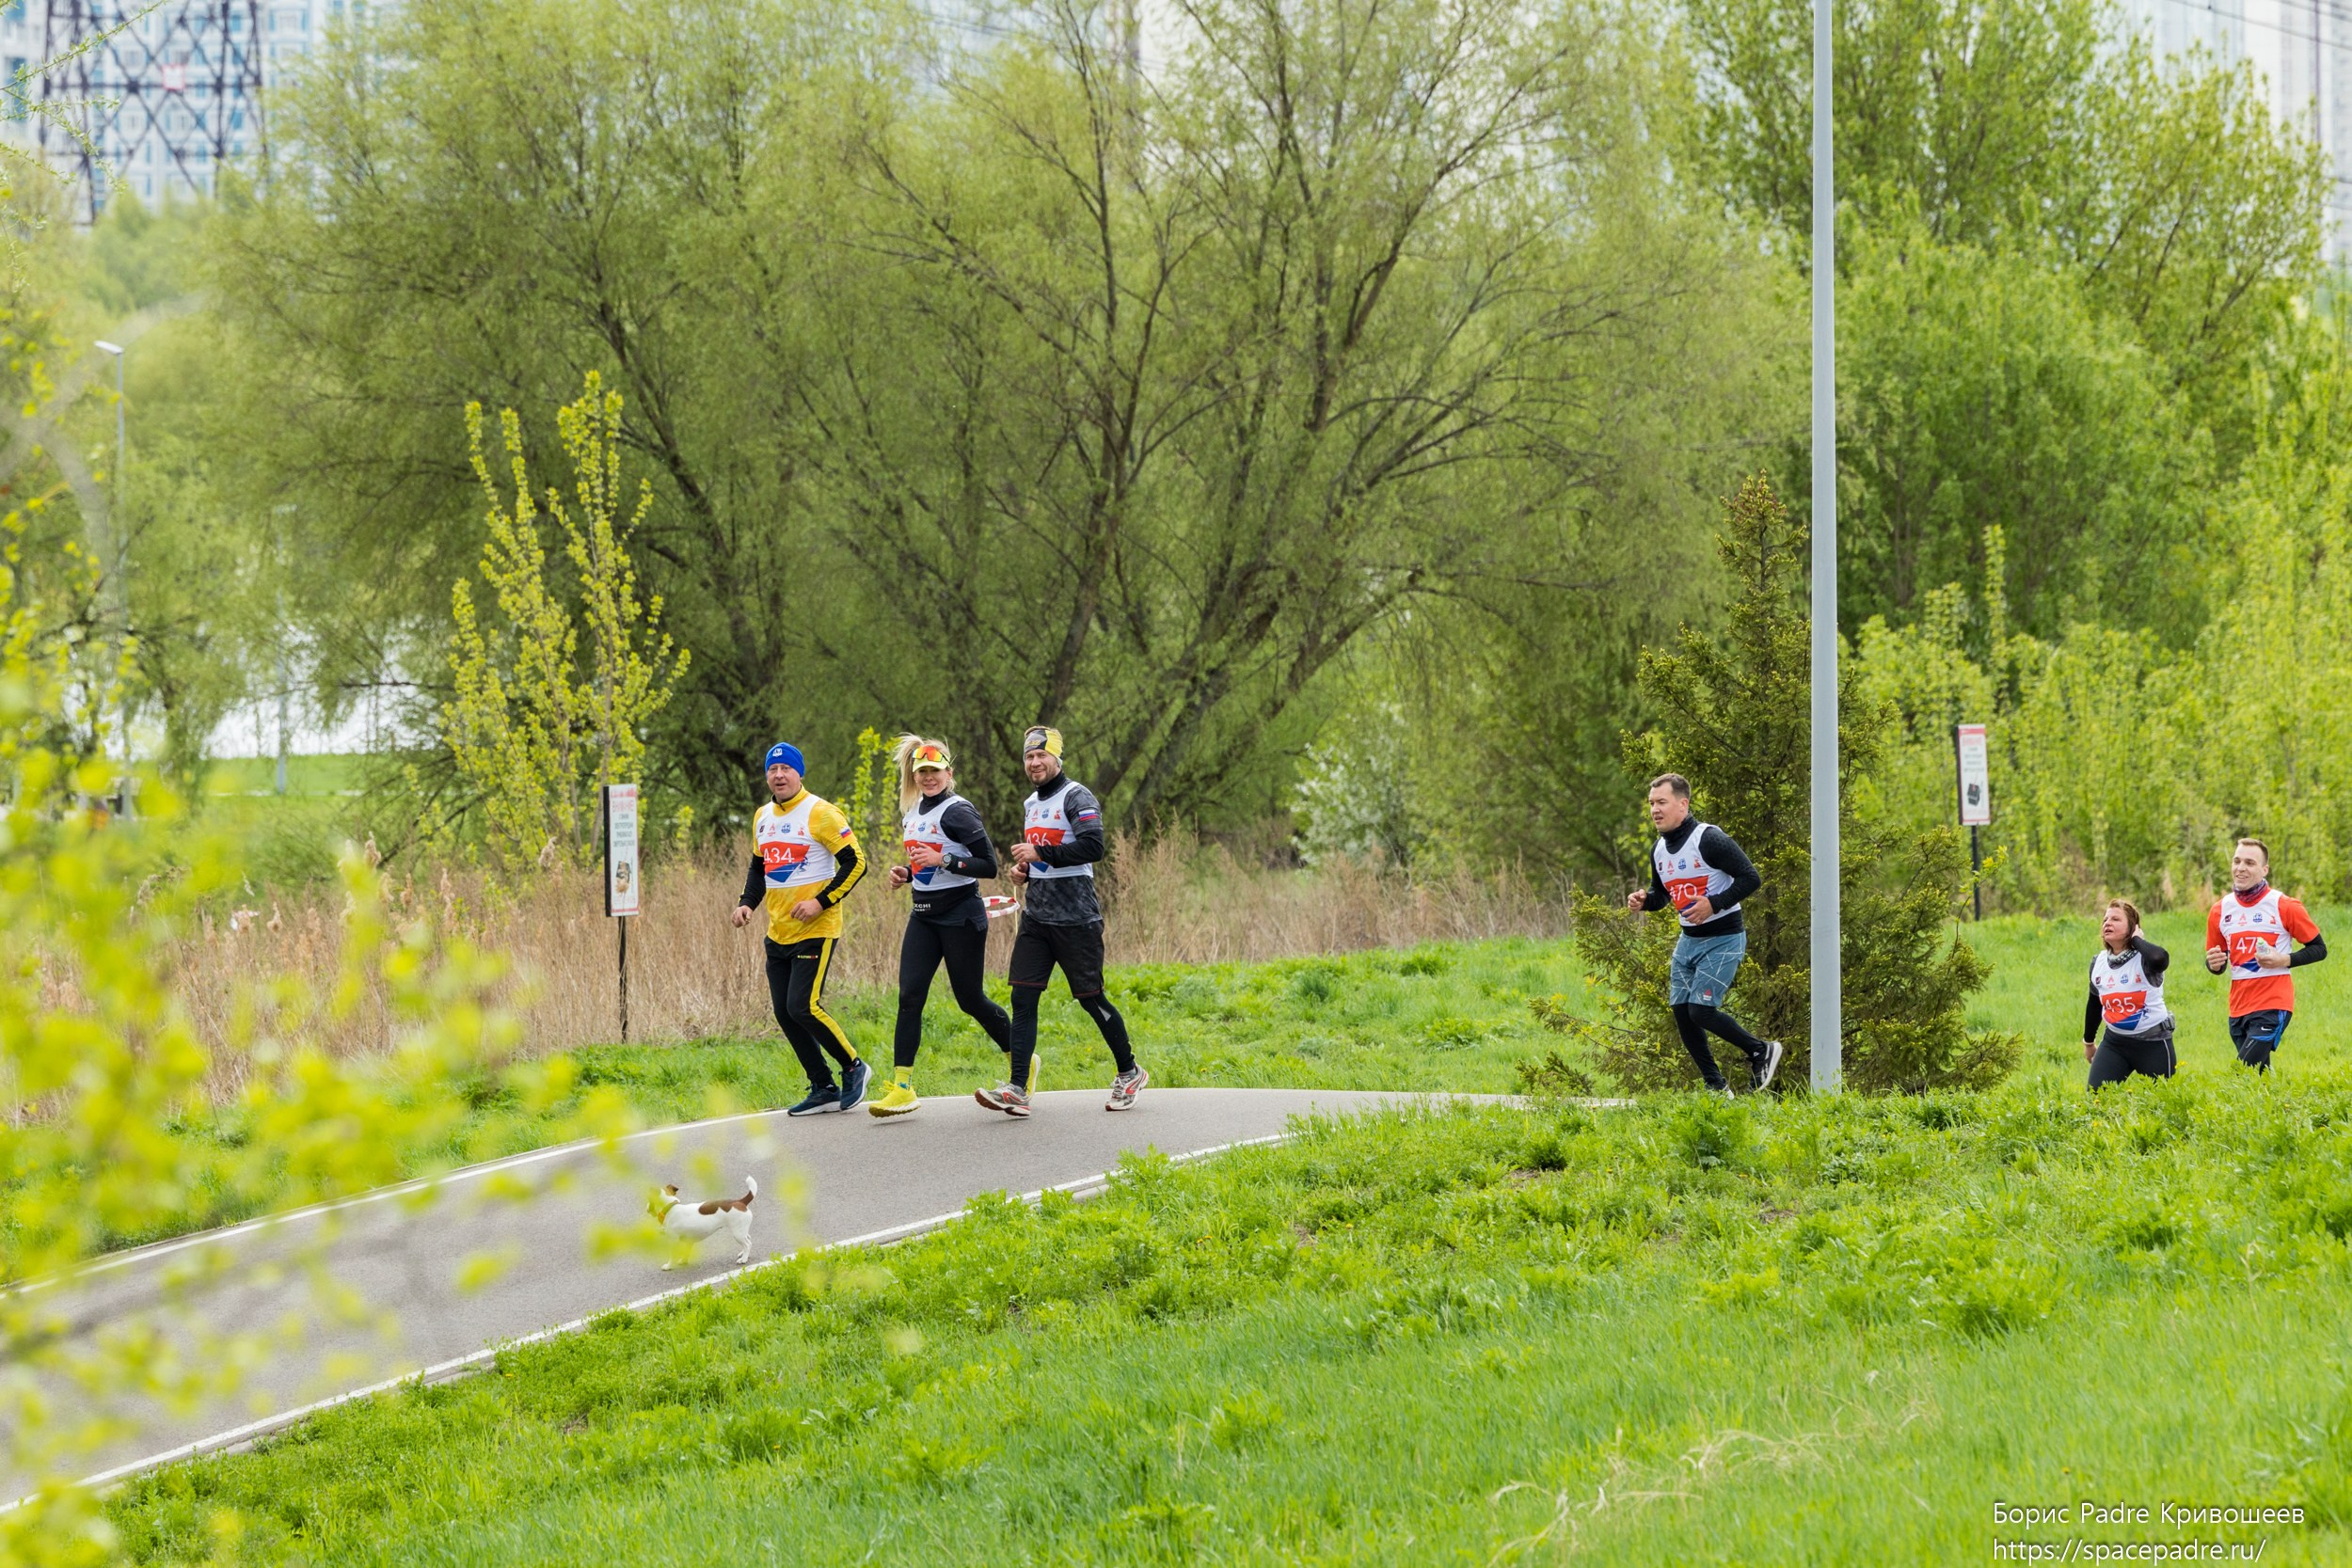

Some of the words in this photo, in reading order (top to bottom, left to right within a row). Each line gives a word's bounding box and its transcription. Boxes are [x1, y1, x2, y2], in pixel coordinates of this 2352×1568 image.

[763, 847, 795, 863] 434
[1670, 883, 1697, 901] 470
[2236, 937, 2258, 954] 47
[2105, 997, 2136, 1013] 435
